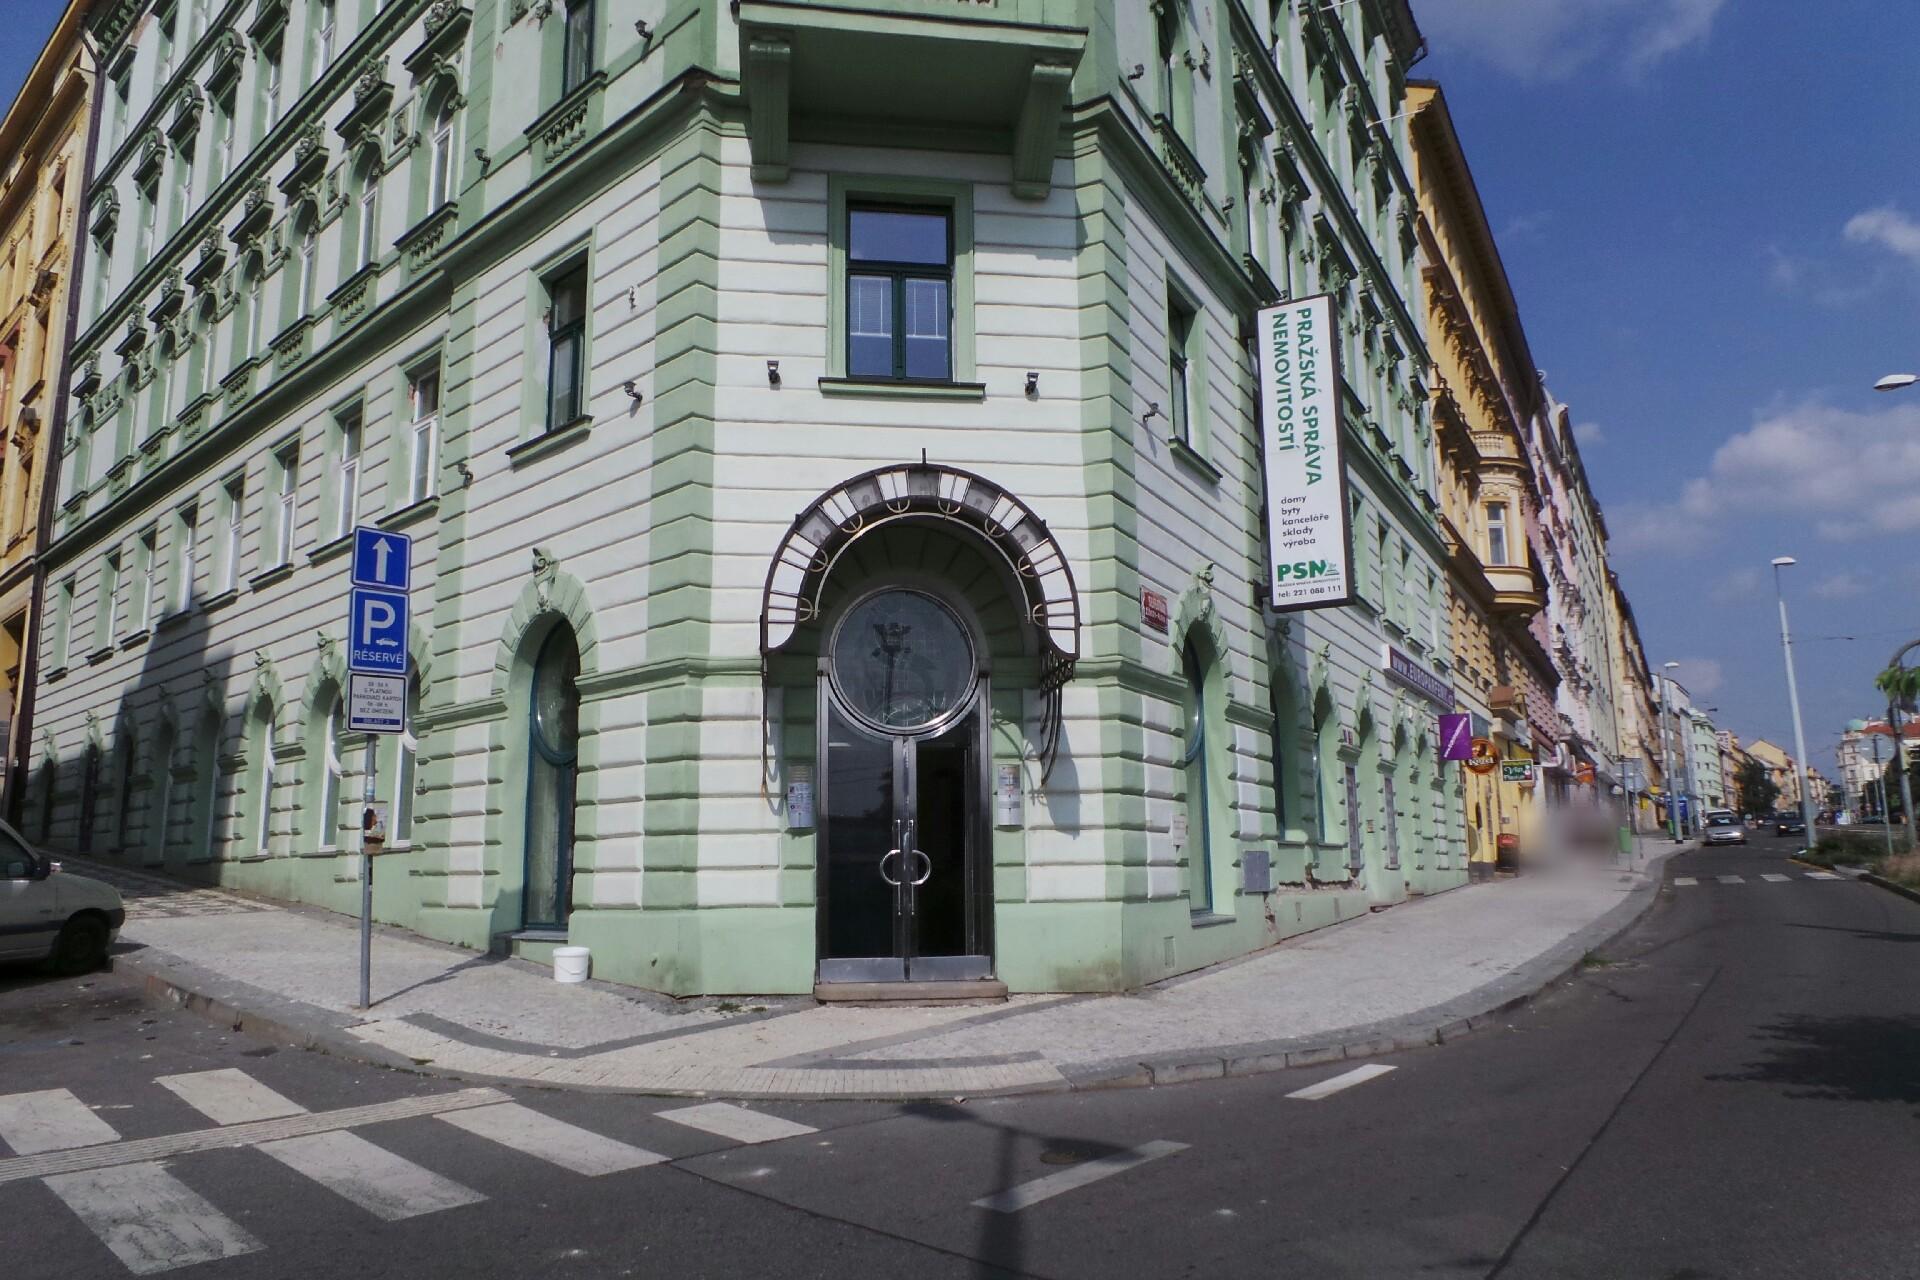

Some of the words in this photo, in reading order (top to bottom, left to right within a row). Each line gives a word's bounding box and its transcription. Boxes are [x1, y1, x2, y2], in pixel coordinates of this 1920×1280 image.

[1296, 308, 1322, 400] PRAŽSKÁ
[1272, 313, 1299, 452] NEMOVITOSTÍ
[1303, 406, 1325, 486] SPRÁVA
[1281, 494, 1307, 506] domy
[1281, 505, 1301, 517] byty
[1282, 512, 1329, 526] kanceláře
[1282, 525, 1314, 538] sklady
[1283, 537, 1316, 549] výroba
[1277, 560, 1327, 582] PSN
[1293, 589, 1307, 597] 221
[1328, 585, 1341, 593] 111
[363, 599, 396, 646] P
[353, 648, 403, 664] RÉSERVÉ
